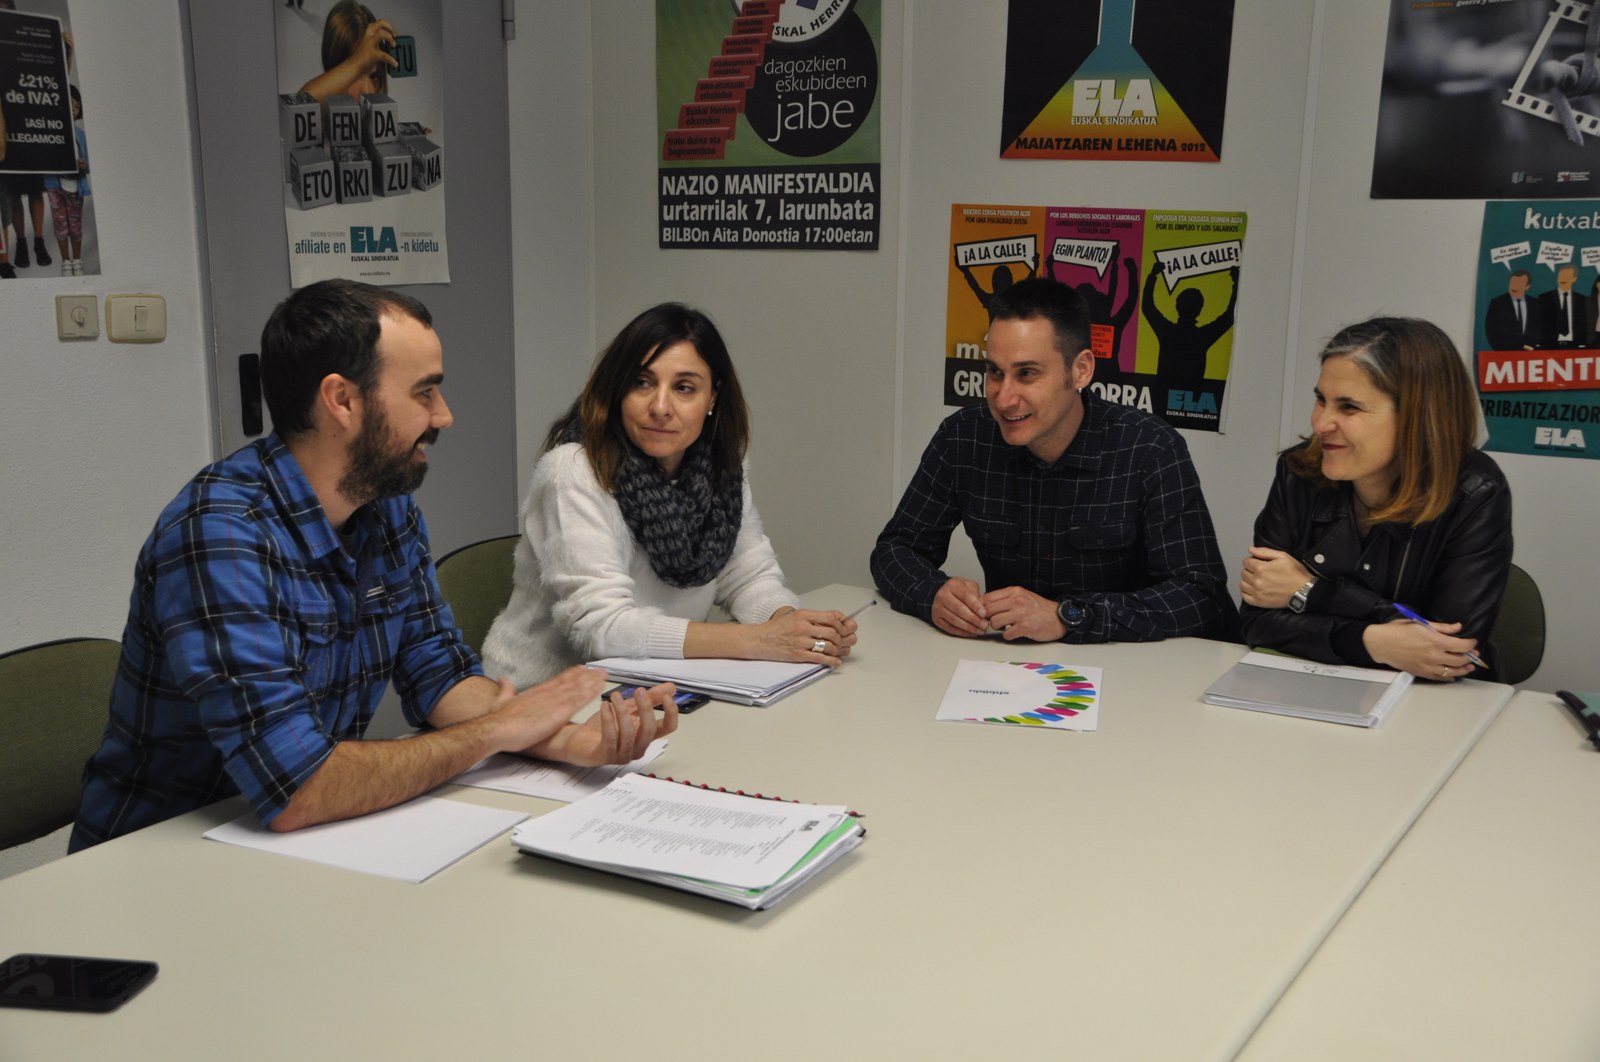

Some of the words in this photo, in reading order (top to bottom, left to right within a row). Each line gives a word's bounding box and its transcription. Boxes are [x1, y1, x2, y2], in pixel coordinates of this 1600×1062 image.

[772, 25, 806, 37] SKAL
[810, 0, 844, 31] HERR
[395, 43, 413, 73] TU
[764, 55, 846, 78] dagozkien
[18, 73, 59, 90] ¿21%
[775, 73, 867, 92] eskubideen
[5, 89, 25, 104] de
[27, 90, 60, 106] IVA?
[1071, 78, 1158, 117] ELA
[24, 116, 46, 129] ¡ASÍ
[47, 119, 63, 130] NO
[294, 111, 316, 143] DE
[332, 111, 359, 142] FEN
[374, 110, 396, 139] DA
[767, 92, 855, 143] jabe
[1071, 116, 1102, 125] EUSKAL
[1104, 116, 1157, 125] SINDIKATUA
[6, 132, 65, 144] LLEGAMOS!
[1015, 137, 1112, 151] MAIATZAREN
[1117, 137, 1177, 152] LEHENA
[1180, 142, 1206, 152] 2012
[303, 168, 333, 202] ETO
[343, 168, 369, 198] RKI
[386, 162, 408, 192] ZU
[427, 154, 441, 186] NA
[662, 175, 718, 196] NAZIO
[724, 172, 874, 195] MANIFESTALDIA
[662, 199, 748, 221] urtarrilak
[754, 199, 772, 225] 7,
[779, 198, 874, 221] larunbata
[349, 226, 398, 253] ELA
[400, 242, 409, 252] -n
[411, 239, 439, 252] kidetu
[662, 227, 709, 243] BILBOn
[712, 227, 739, 242] Aita
[742, 227, 799, 242] Donostia
[805, 227, 873, 243] 17:00etan
[333, 242, 346, 253] en
[964, 247, 976, 264] ¡A
[978, 246, 992, 260] LA
[993, 242, 1027, 259] CALLE!
[1055, 244, 1075, 257] EGIN
[1074, 245, 1109, 264] PLANTO!
[1166, 257, 1181, 274] ¡A
[1183, 254, 1199, 269] LA
[1200, 246, 1239, 266] CALLE!
[953, 369, 987, 398] GR
[1090, 381, 1153, 414] ORRA
[1166, 389, 1218, 414] ELA
[1166, 410, 1185, 418] EUSKAL
[1186, 412, 1217, 420] SINDIKATUA
[1534, 426, 1586, 448] ELA
